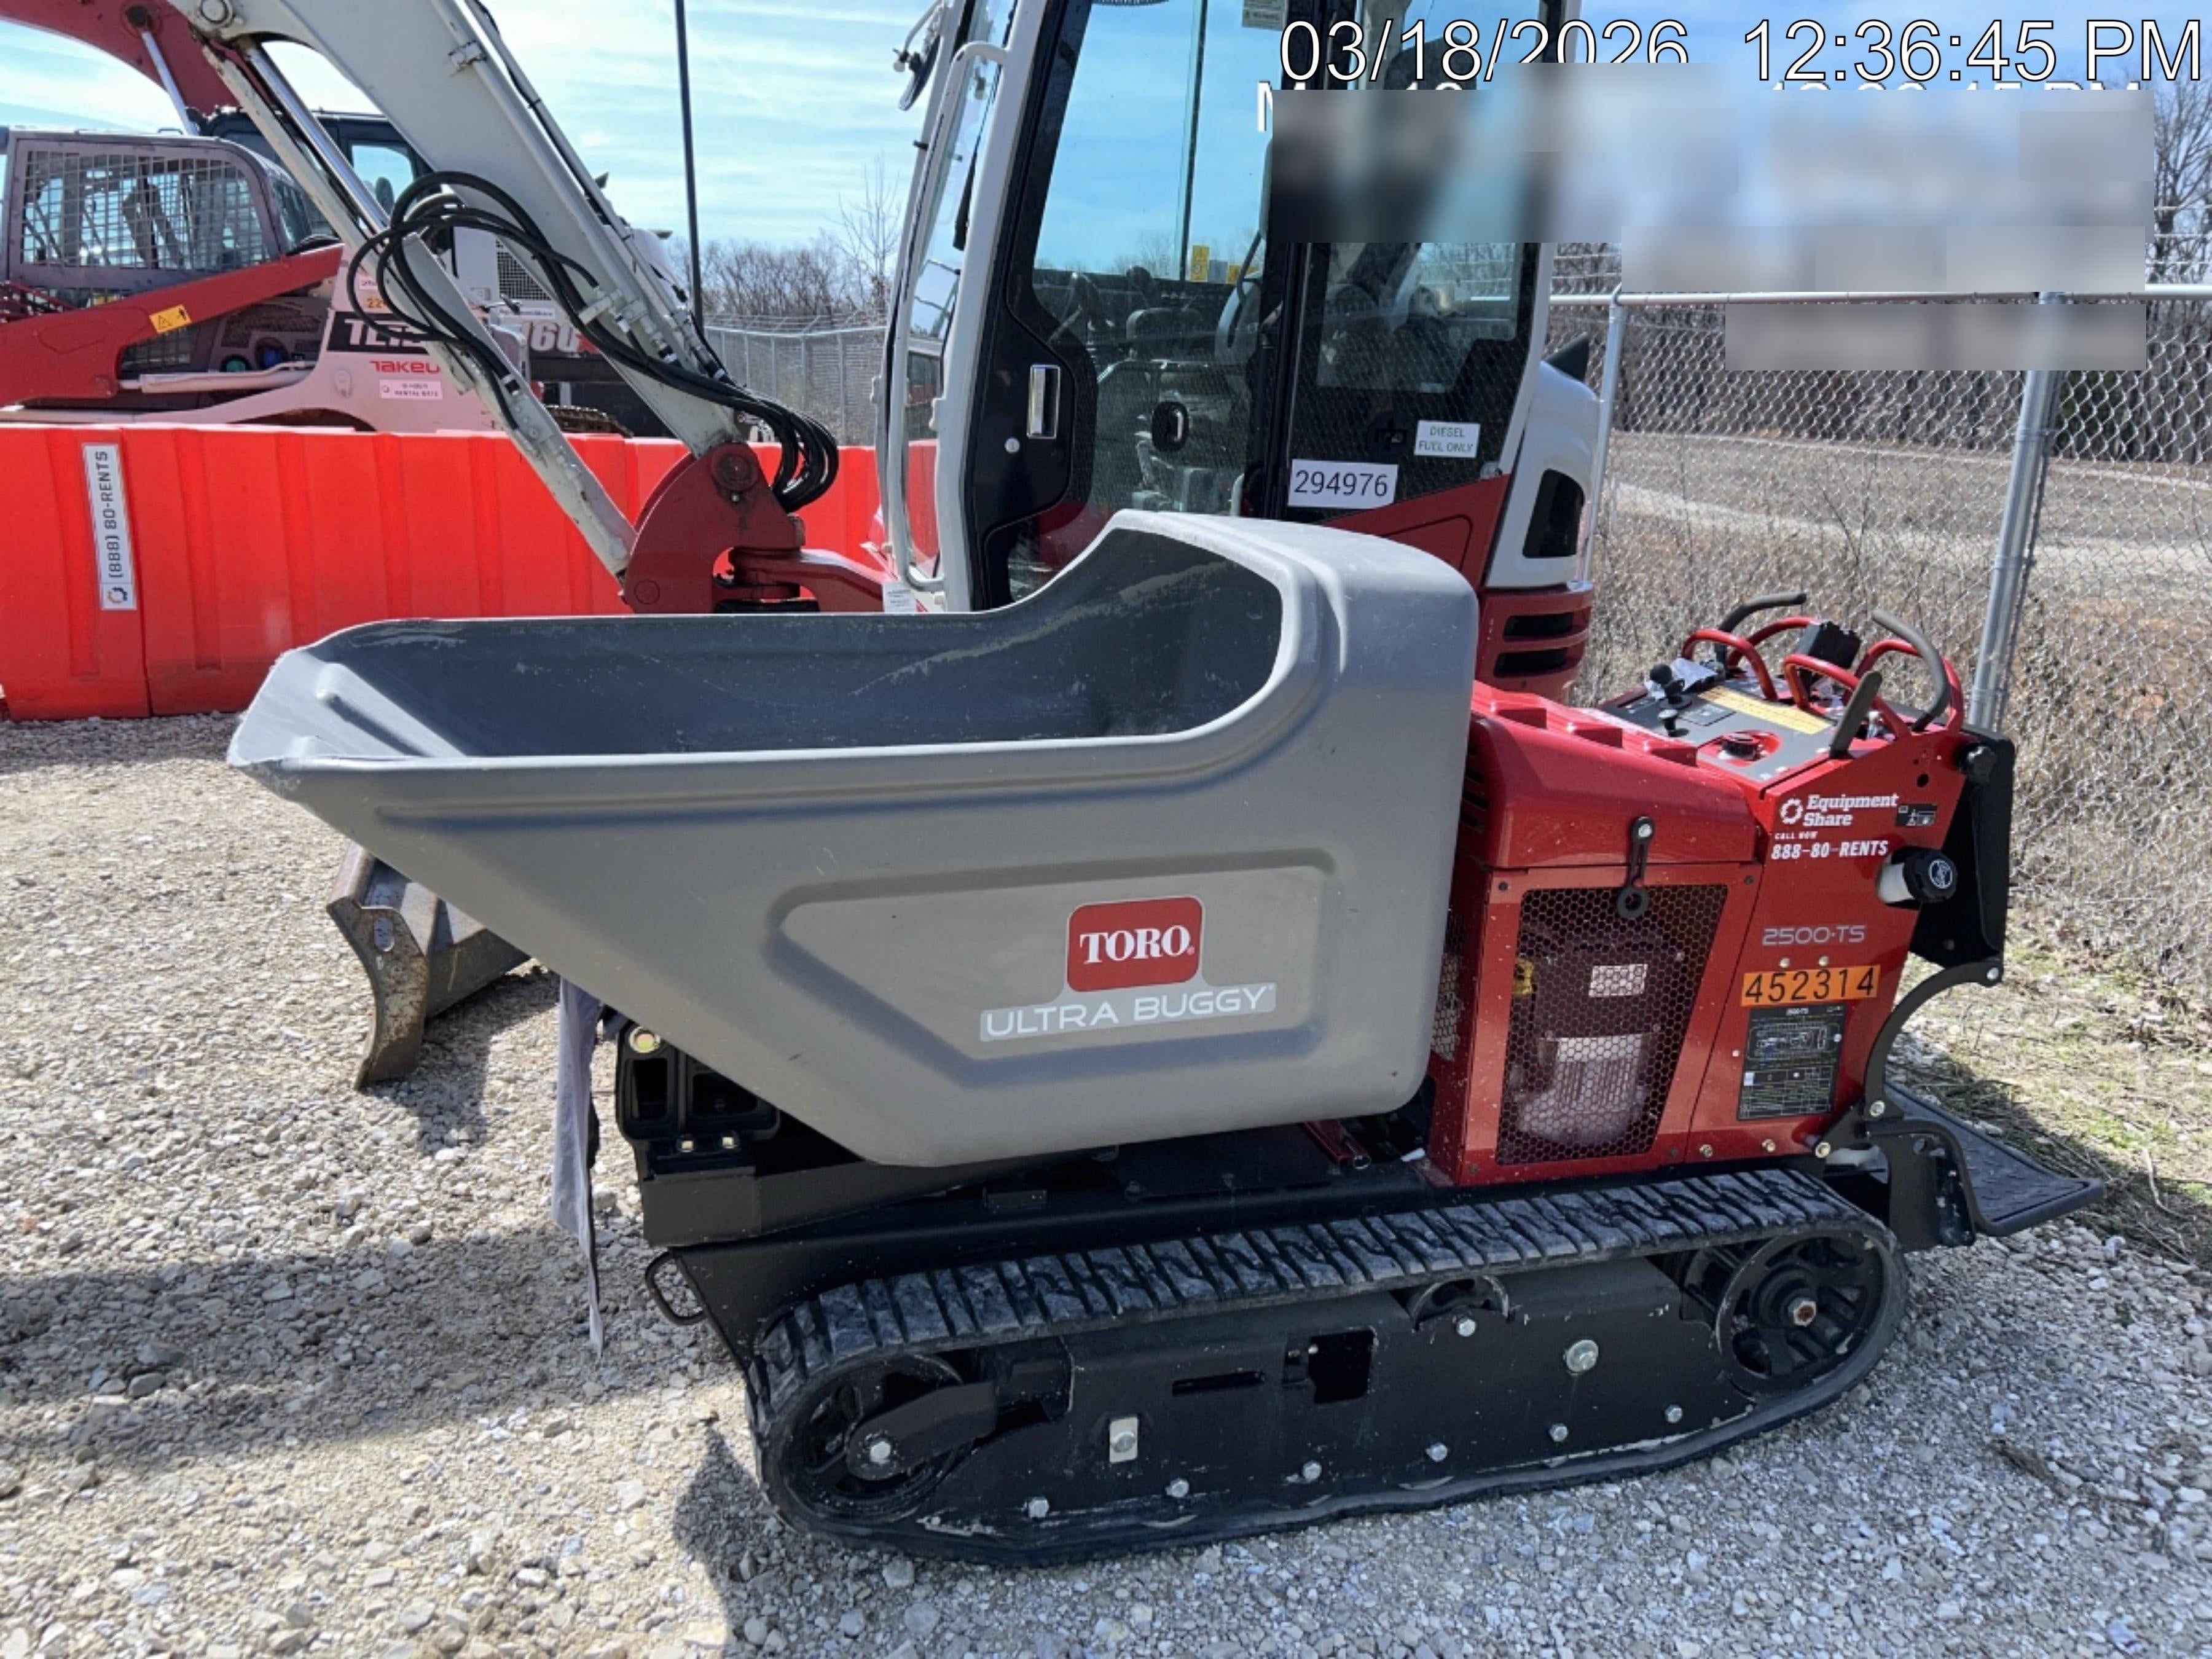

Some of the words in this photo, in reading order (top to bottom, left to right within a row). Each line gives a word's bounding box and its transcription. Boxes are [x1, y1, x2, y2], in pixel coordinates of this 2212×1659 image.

[1430, 426, 1465, 437] DIESEL
[1419, 441, 1443, 452] FUEL
[1446, 442, 1473, 453] ONLY
[95, 451, 117, 530] 80-RENTS
[1293, 469, 1388, 497] 294976
[105, 535, 123, 578] (888)
[1806, 793, 1899, 812] Equipment
[1803, 812, 1853, 826] Share
[1771, 840, 1889, 860] 888-80-RENTS
[1080, 925, 1191, 964] TORO
[1744, 967, 1875, 1003] 452314
[986, 1002, 1120, 1037] ULTRA
[1134, 986, 1266, 1021] BUGGY
